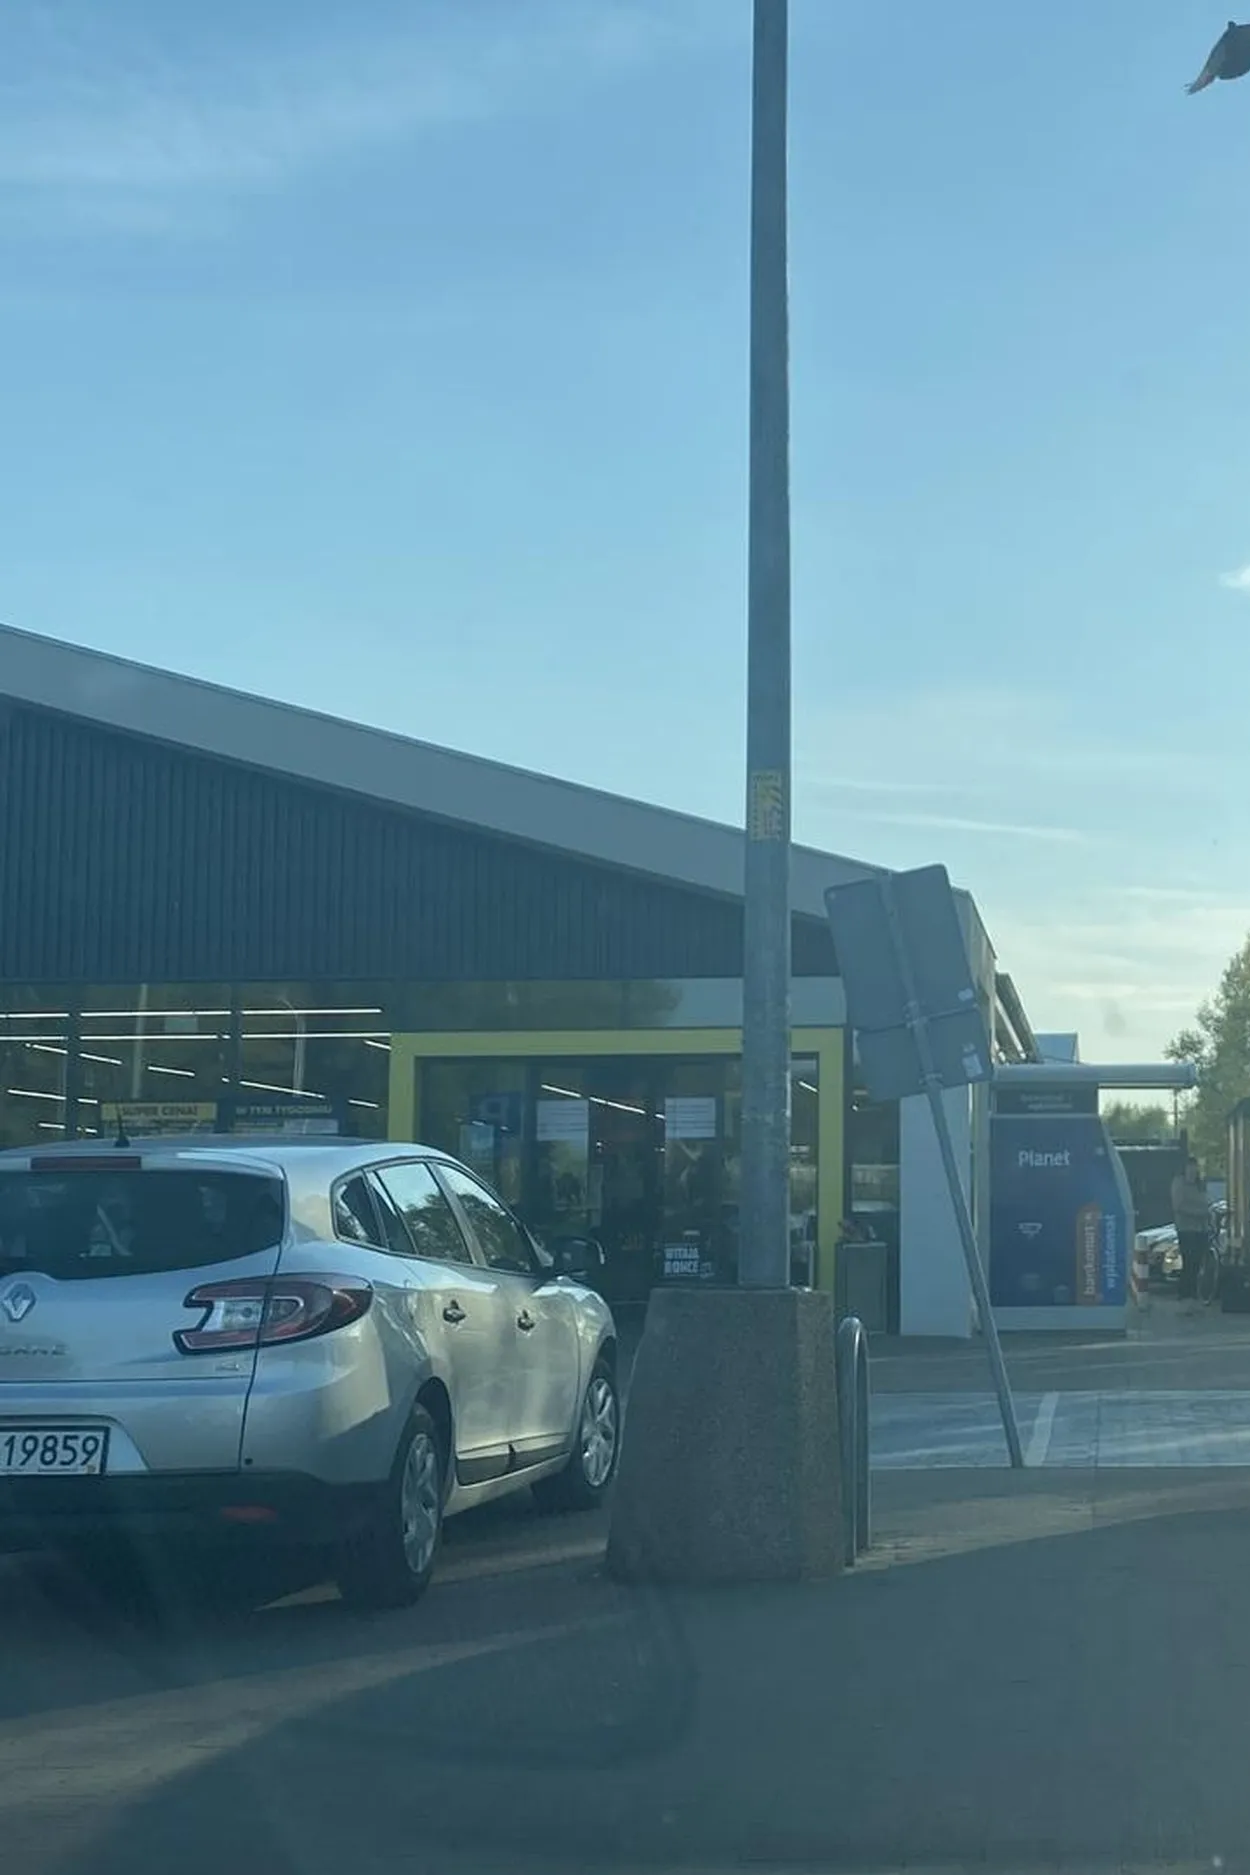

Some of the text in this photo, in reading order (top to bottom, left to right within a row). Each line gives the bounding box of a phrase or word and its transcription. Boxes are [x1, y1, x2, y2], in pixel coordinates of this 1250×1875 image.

[1018, 1149, 1071, 1167] Planet
[1083, 1226, 1096, 1296] bankomat
[3, 1434, 100, 1467] 19859
